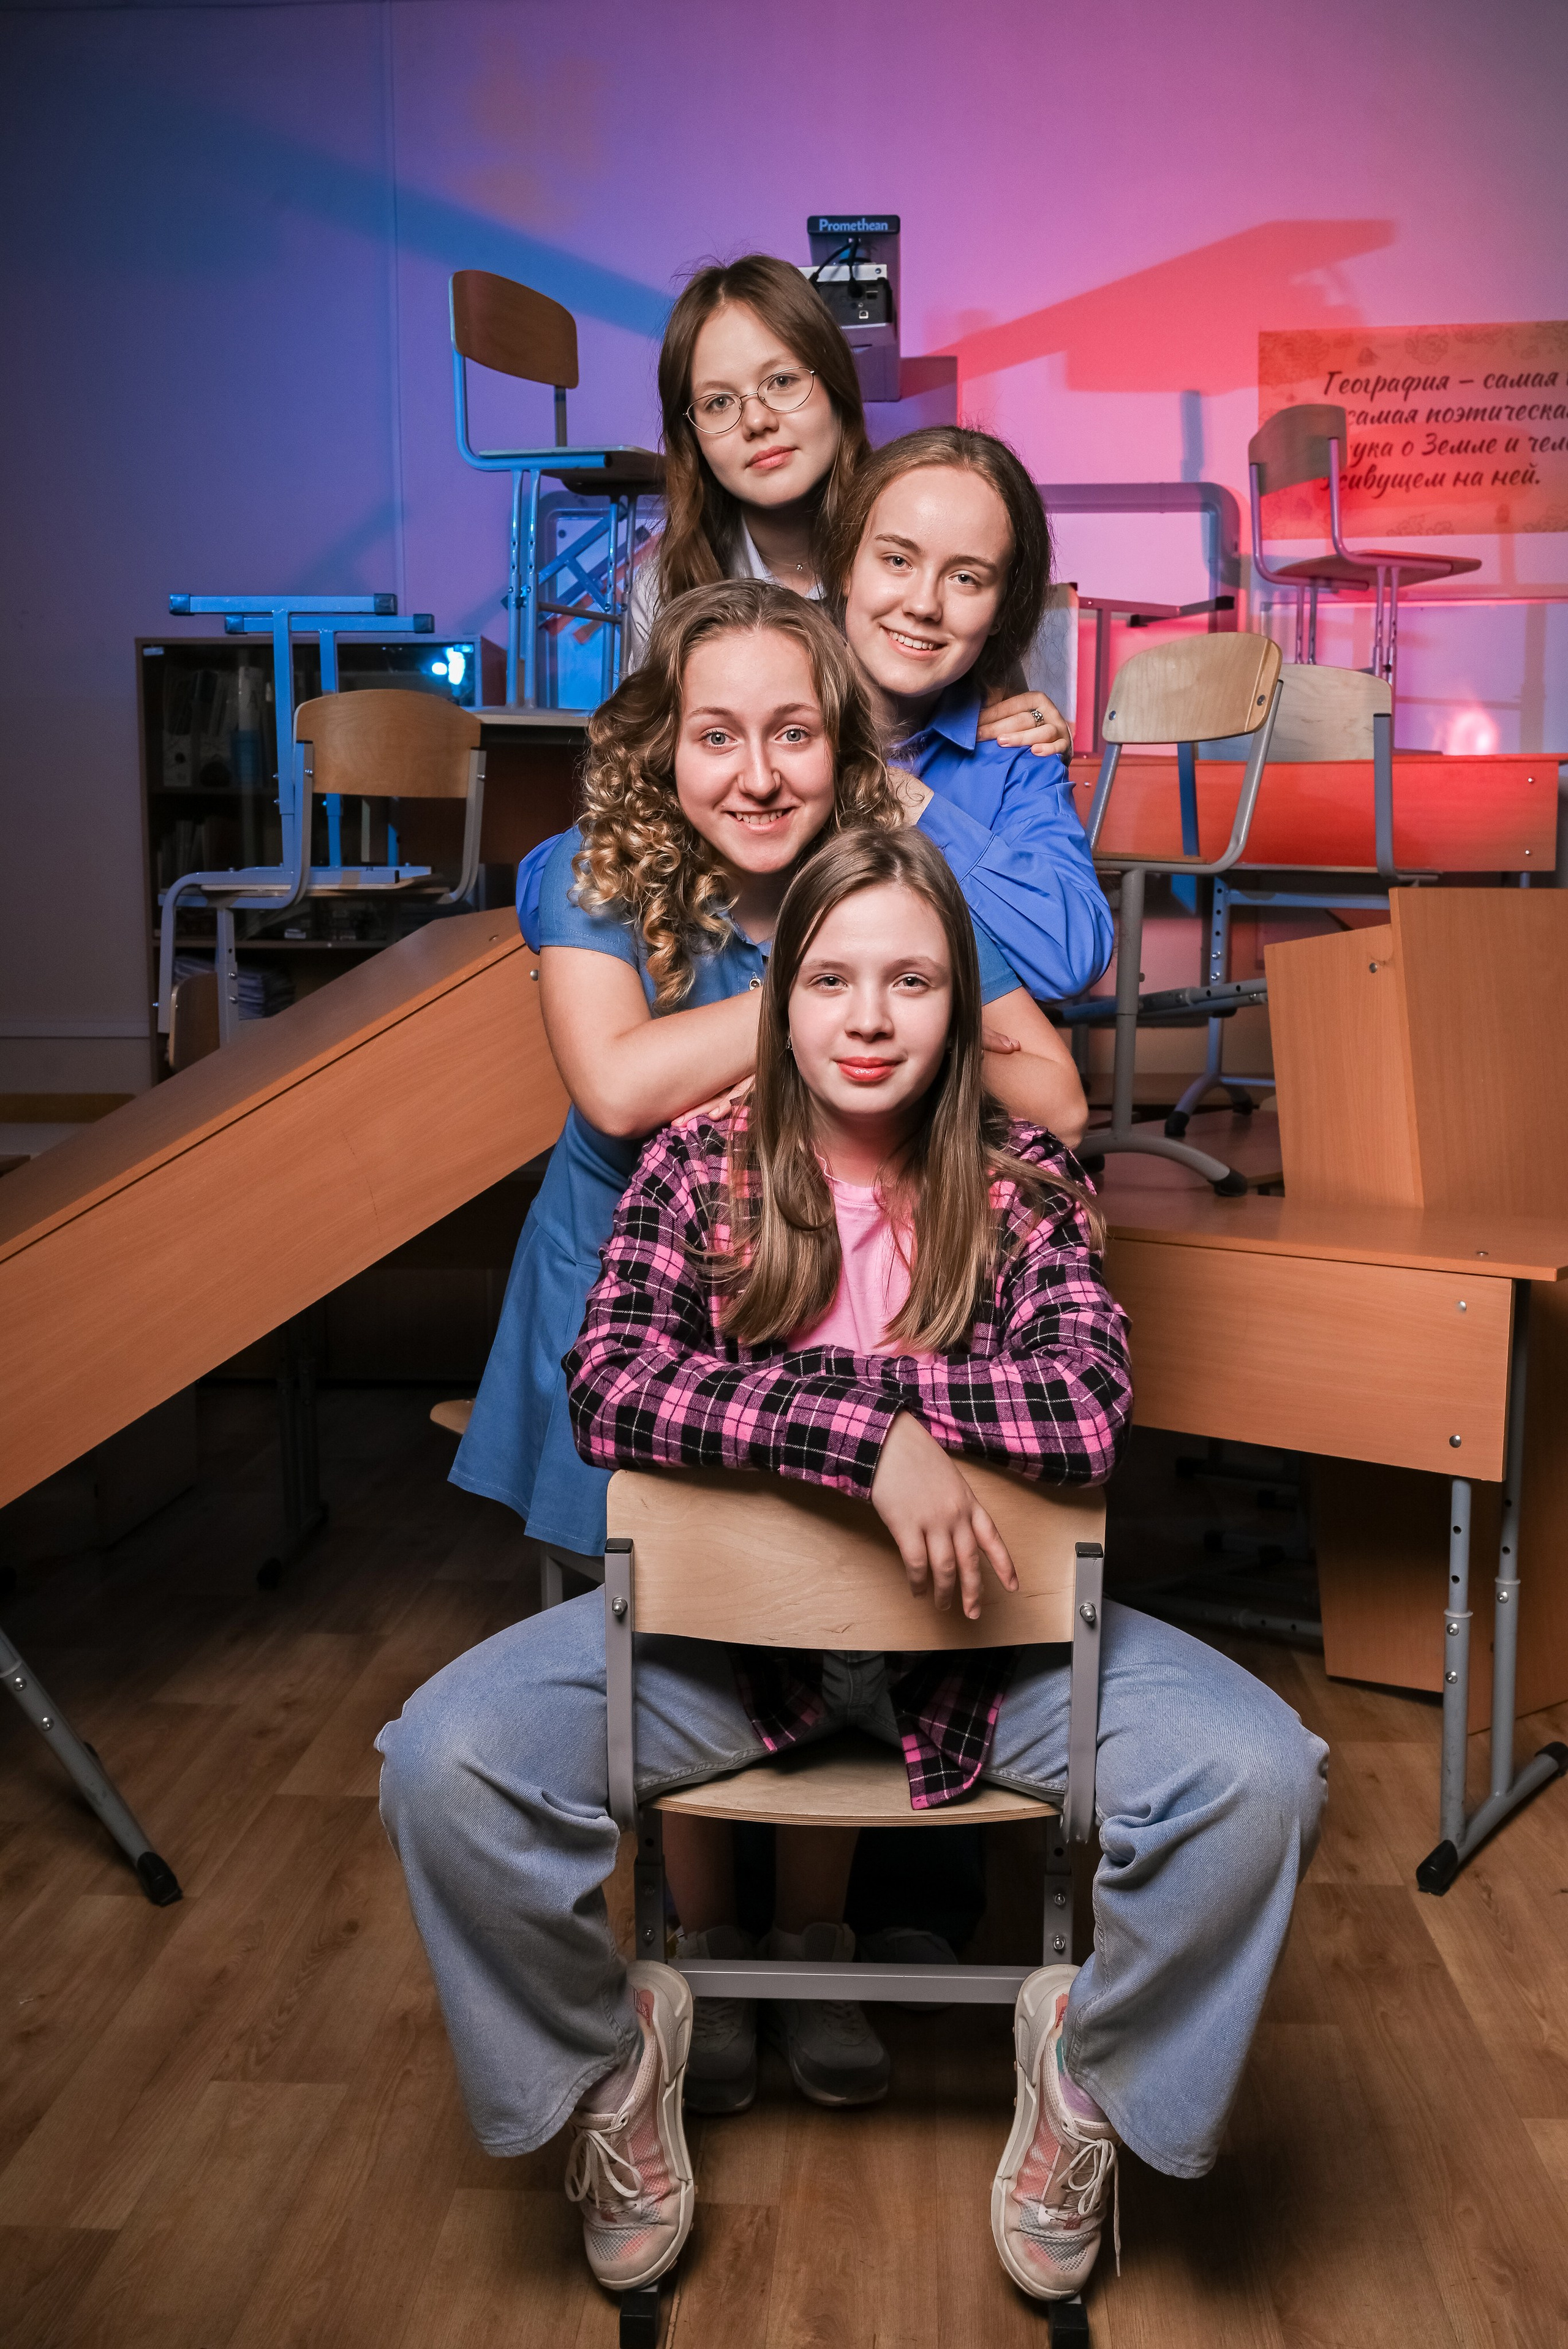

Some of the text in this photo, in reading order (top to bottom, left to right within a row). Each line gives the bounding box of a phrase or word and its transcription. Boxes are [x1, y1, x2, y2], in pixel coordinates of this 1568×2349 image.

[819, 218, 888, 231] Promethean
[1324, 371, 1450, 402] География
[1483, 372, 1559, 390] самая
[1348, 404, 1568, 425] самая поэтическа
[1349, 432, 1568, 468] ука о Земле и чел
[1452, 470, 1483, 488] на
[1491, 462, 1540, 486] ней.
